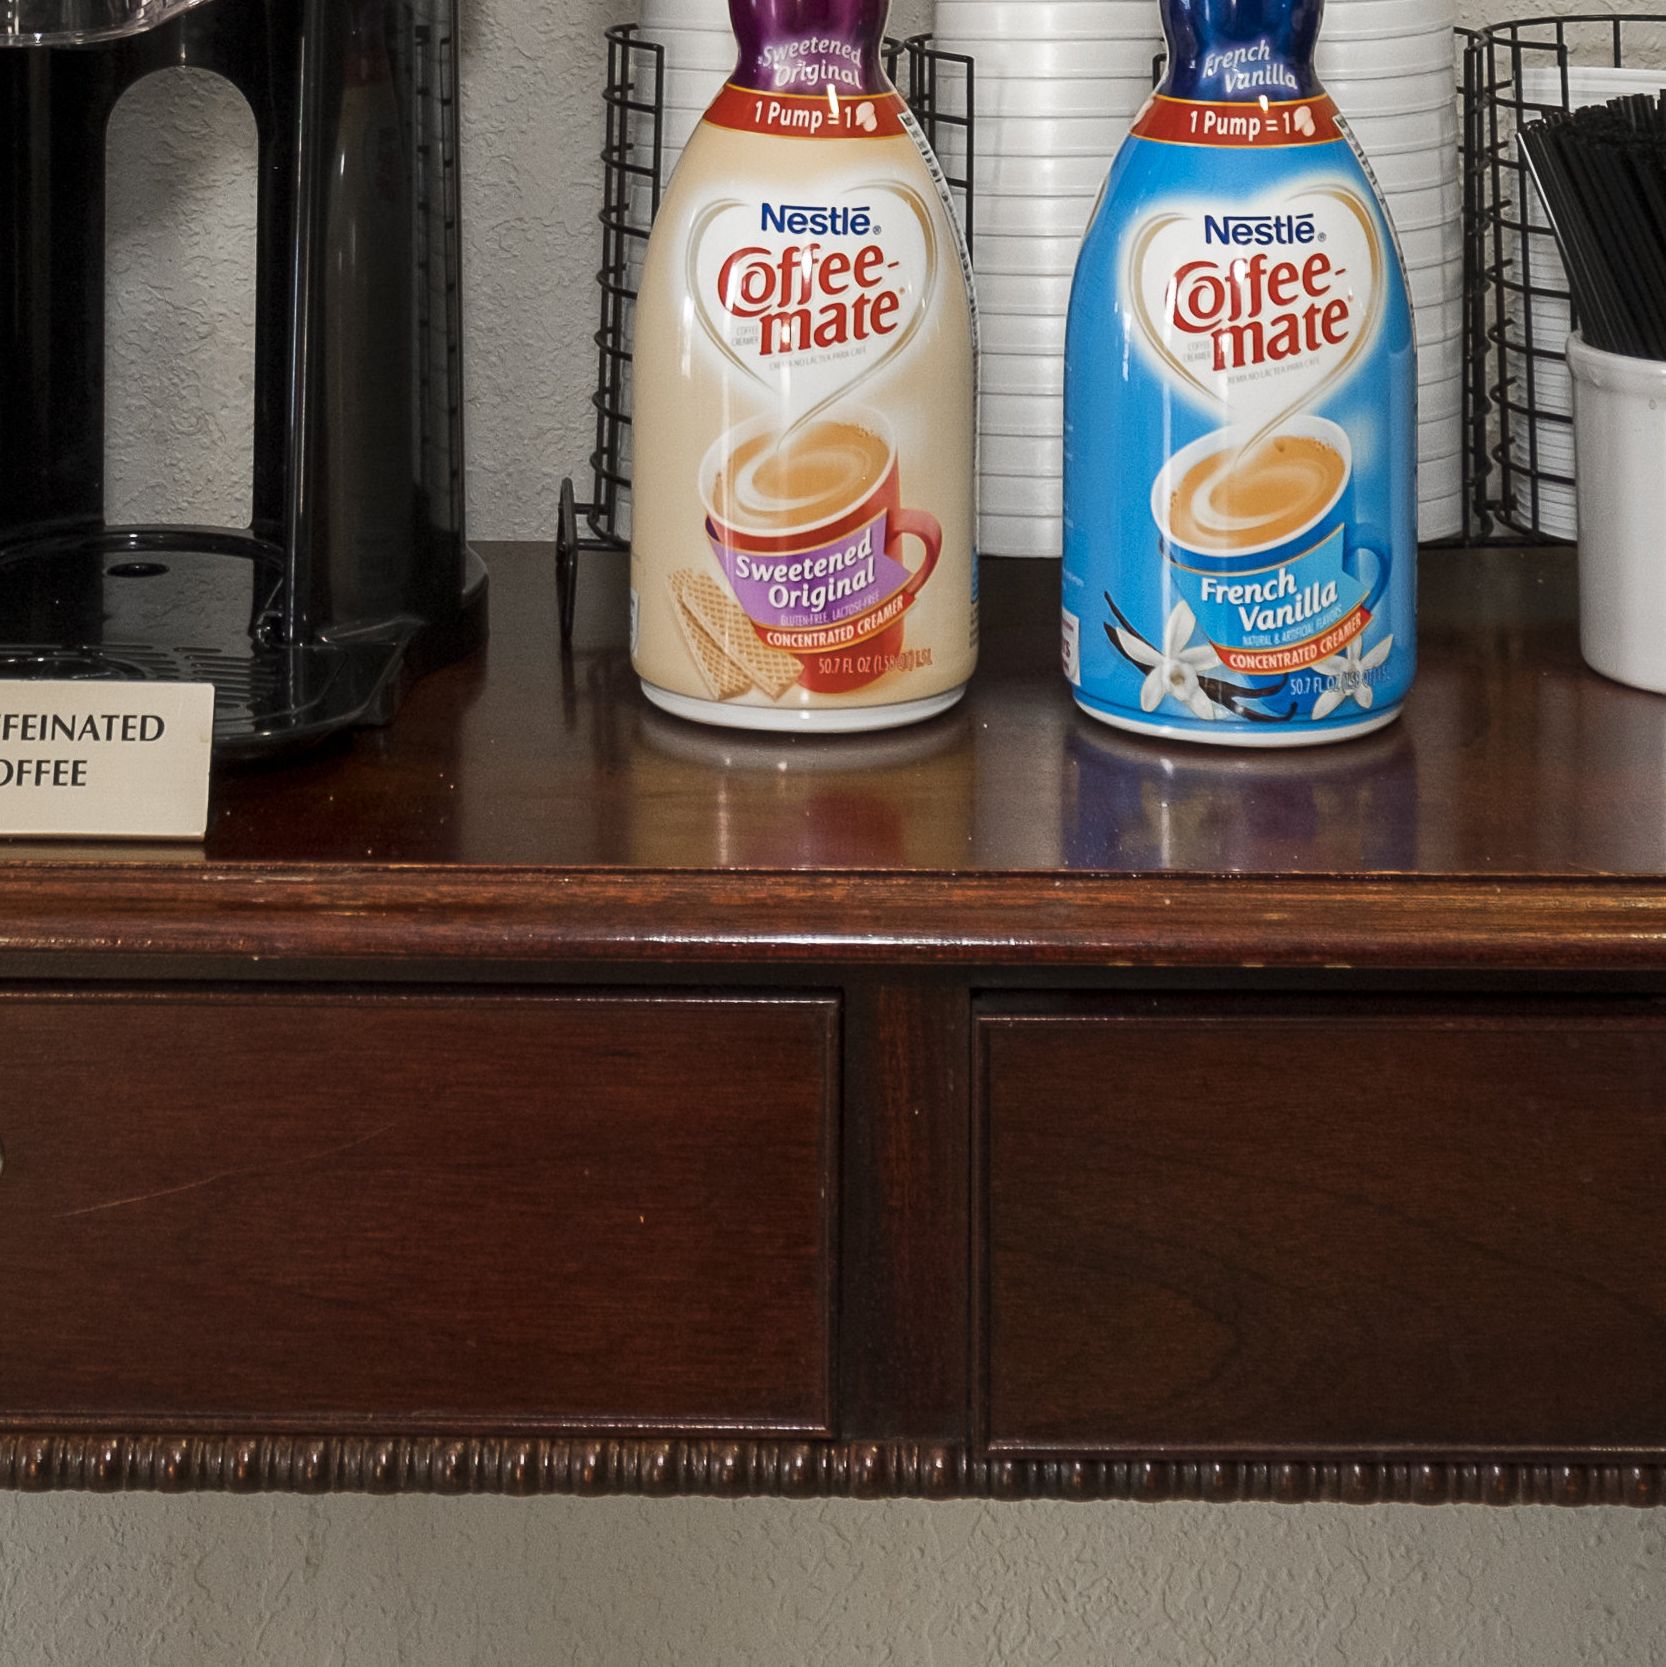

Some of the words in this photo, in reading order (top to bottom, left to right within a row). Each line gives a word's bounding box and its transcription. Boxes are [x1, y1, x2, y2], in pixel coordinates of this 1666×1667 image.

[763, 37, 862, 68] Sweetened
[1202, 39, 1270, 78] French
[775, 59, 863, 90] Original
[1224, 64, 1298, 93] Vanilla
[755, 100, 763, 123] 1
[767, 101, 823, 134] Pump
[844, 106, 852, 128] 1
[1190, 110, 1198, 134] 1
[1204, 110, 1261, 142] Pump
[1266, 119, 1278, 131] =
[1283, 112, 1290, 134] 1
[761, 202, 871, 236] Nestlé
[1204, 213, 1315, 246] Nestlé
[759, 290, 900, 356] mate
[1211, 298, 1349, 372] mate
[735, 527, 873, 583] Sweetened
[768, 556, 876, 613] Original
[1200, 568, 1297, 605] French
[766, 625, 854, 648] CONCENTRATED
[857, 594, 904, 635] CREAMER
[1238, 580, 1339, 632] Vanilla
[1229, 645, 1318, 669] CONCENTRATED
[1320, 612, 1362, 653] CREAMER
[1242, 633, 1272, 646] NATURAL
[819, 657, 840, 675] 50.7
[842, 656, 854, 673] FL
[857, 656, 871, 674] OZ
[1290, 677, 1311, 695] 50.7
